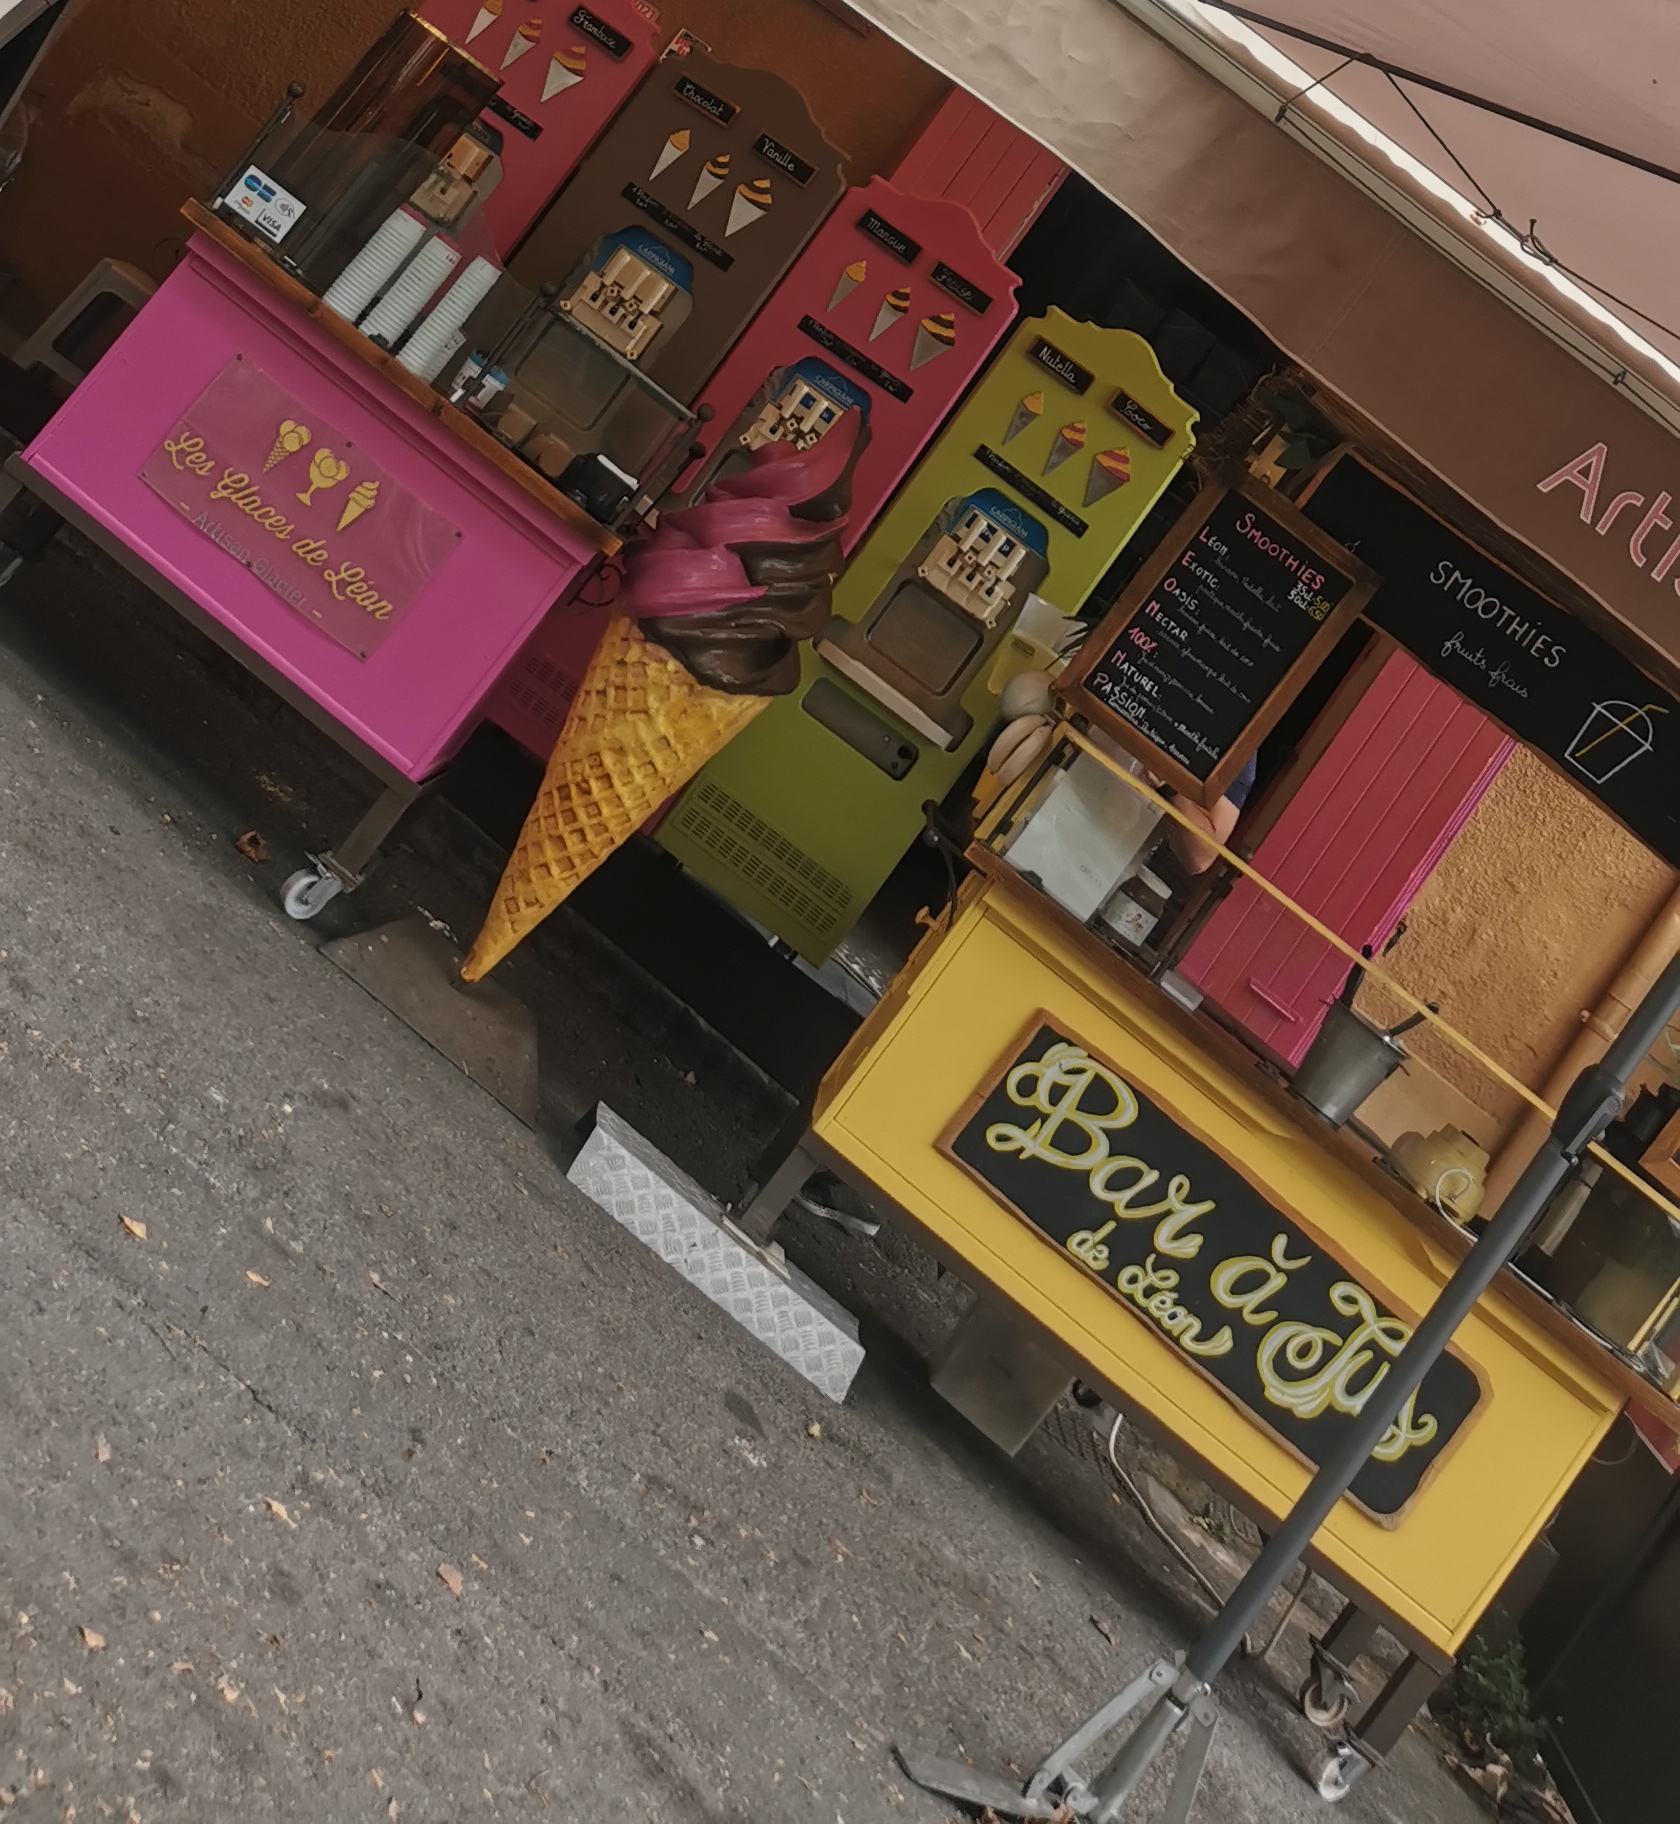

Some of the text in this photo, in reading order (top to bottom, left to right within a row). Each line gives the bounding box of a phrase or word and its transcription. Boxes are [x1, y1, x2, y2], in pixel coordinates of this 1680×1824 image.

[682, 82, 724, 116] Chocolat
[762, 138, 795, 172] Vanille
[262, 214, 282, 231] VISA
[1038, 346, 1076, 383] Nutella
[164, 432, 394, 620] Les Glaces de Léon
[190, 512, 308, 609] Artisan Glacier
[1236, 513, 1325, 590] SMOOTHIES
[1537, 442, 1680, 597] Arti
[1430, 560, 1566, 668] SMOOTHIES
[1440, 631, 1528, 698] fruits frais
[985, 1042, 1217, 1259] Bar
[1066, 1220, 1234, 1358] de Léon
